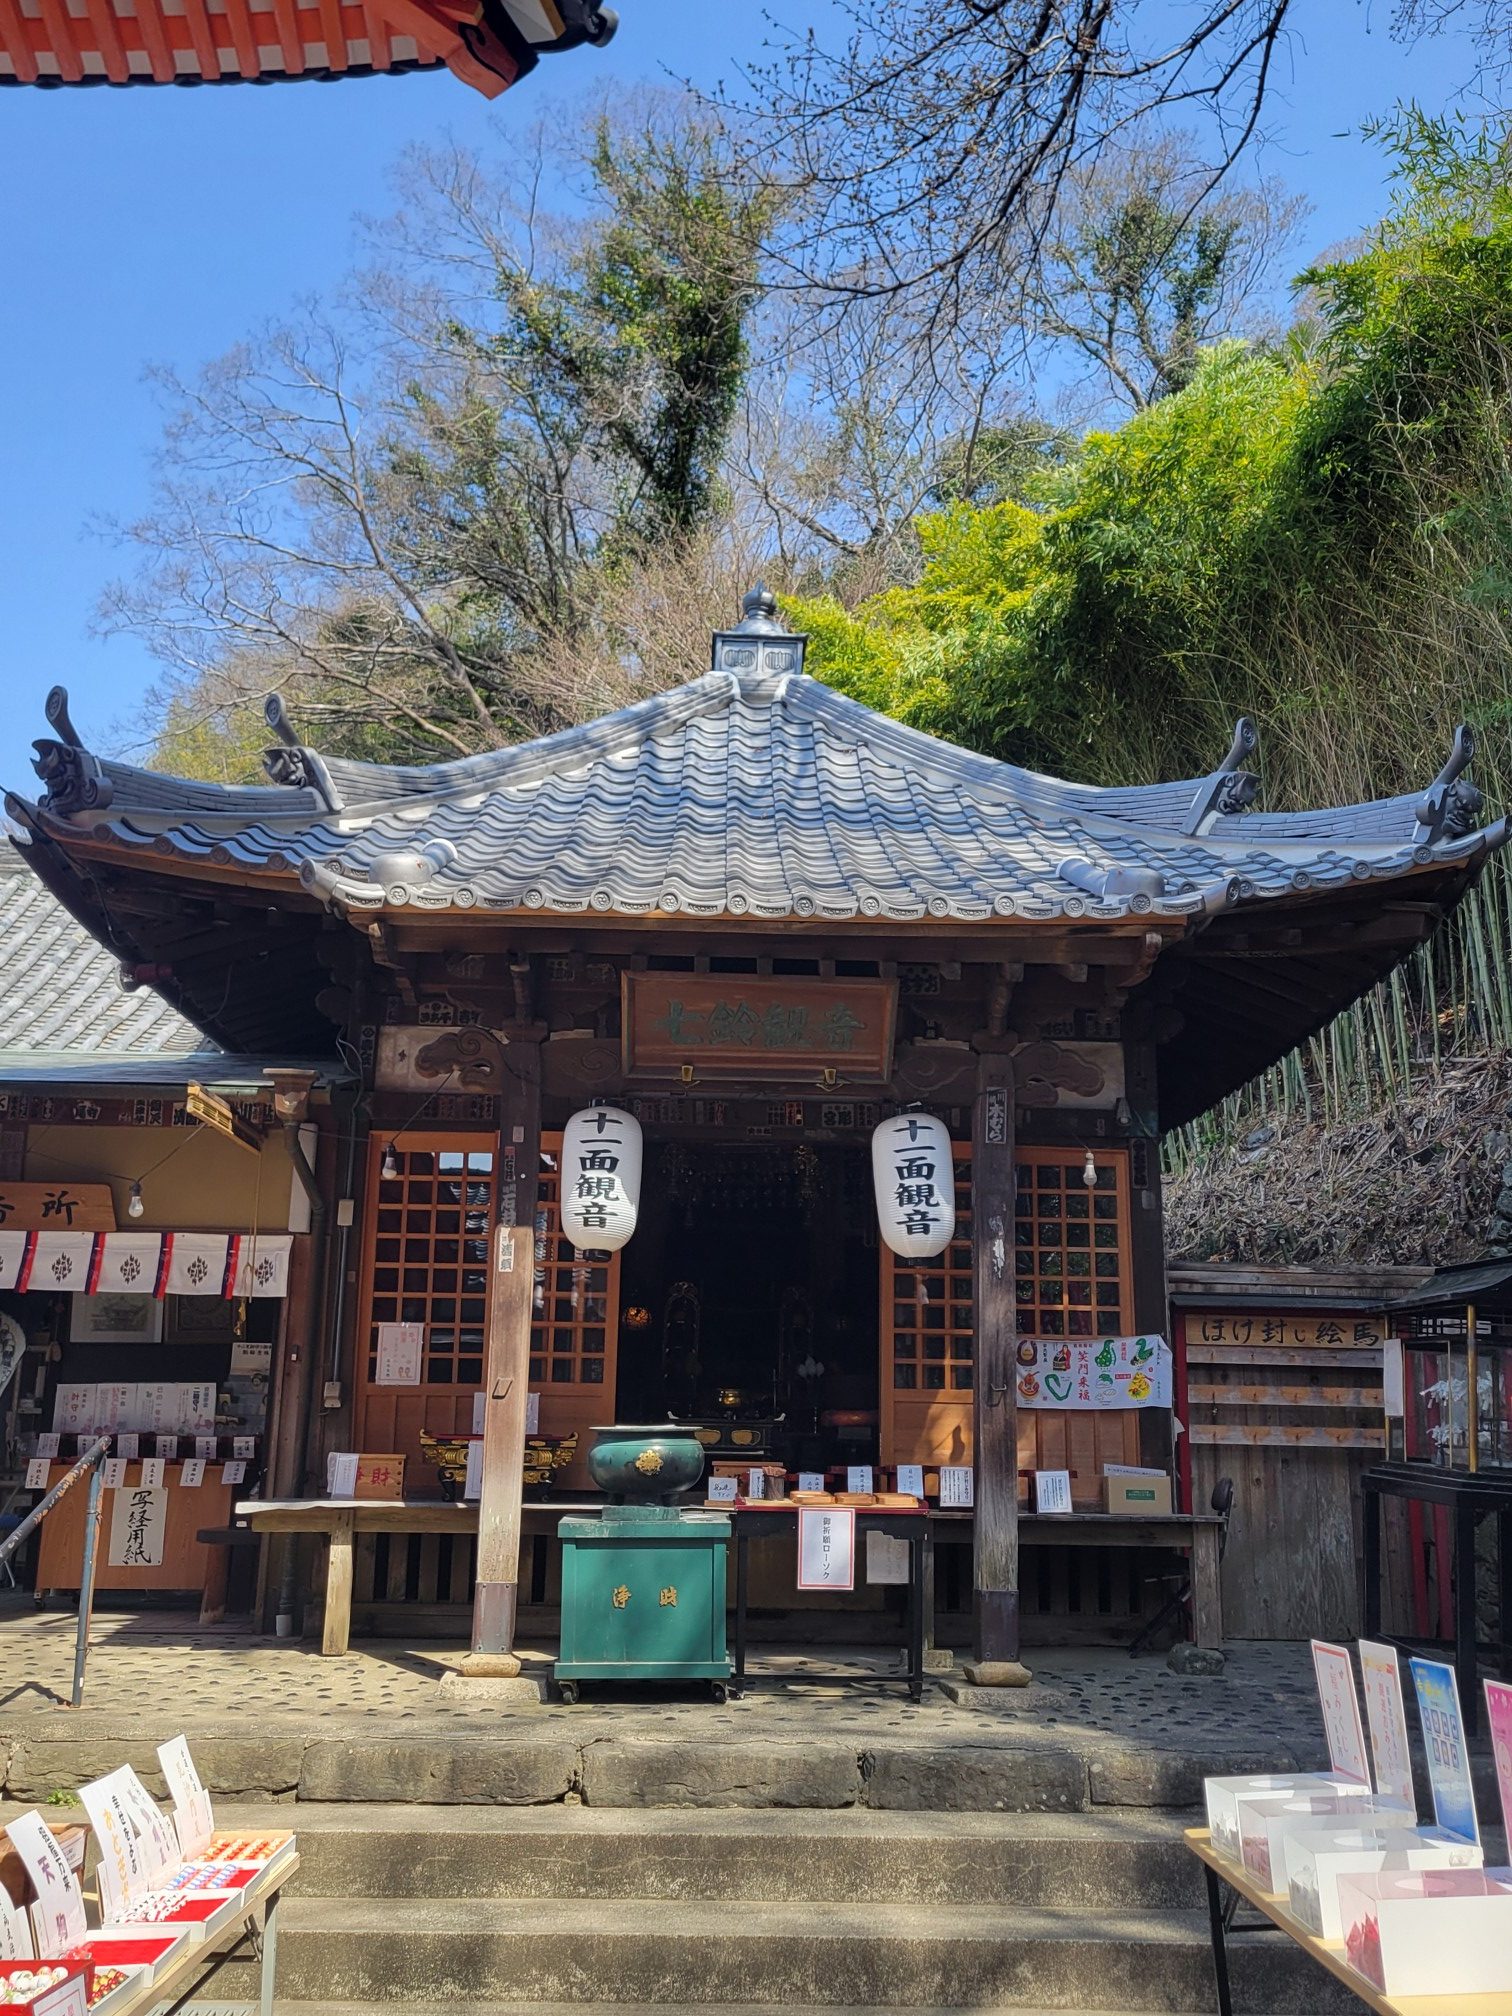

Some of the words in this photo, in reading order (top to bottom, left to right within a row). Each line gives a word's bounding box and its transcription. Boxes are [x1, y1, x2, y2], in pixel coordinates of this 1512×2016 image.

[575, 1112, 624, 1228] 十一面観音
[893, 1119, 941, 1236] 十一面観音
[1201, 1317, 1380, 1347] ぼけ封じ絵馬
[122, 1490, 155, 1565] 写経用紙
[822, 1517, 832, 1580] 御祈願ローソク
